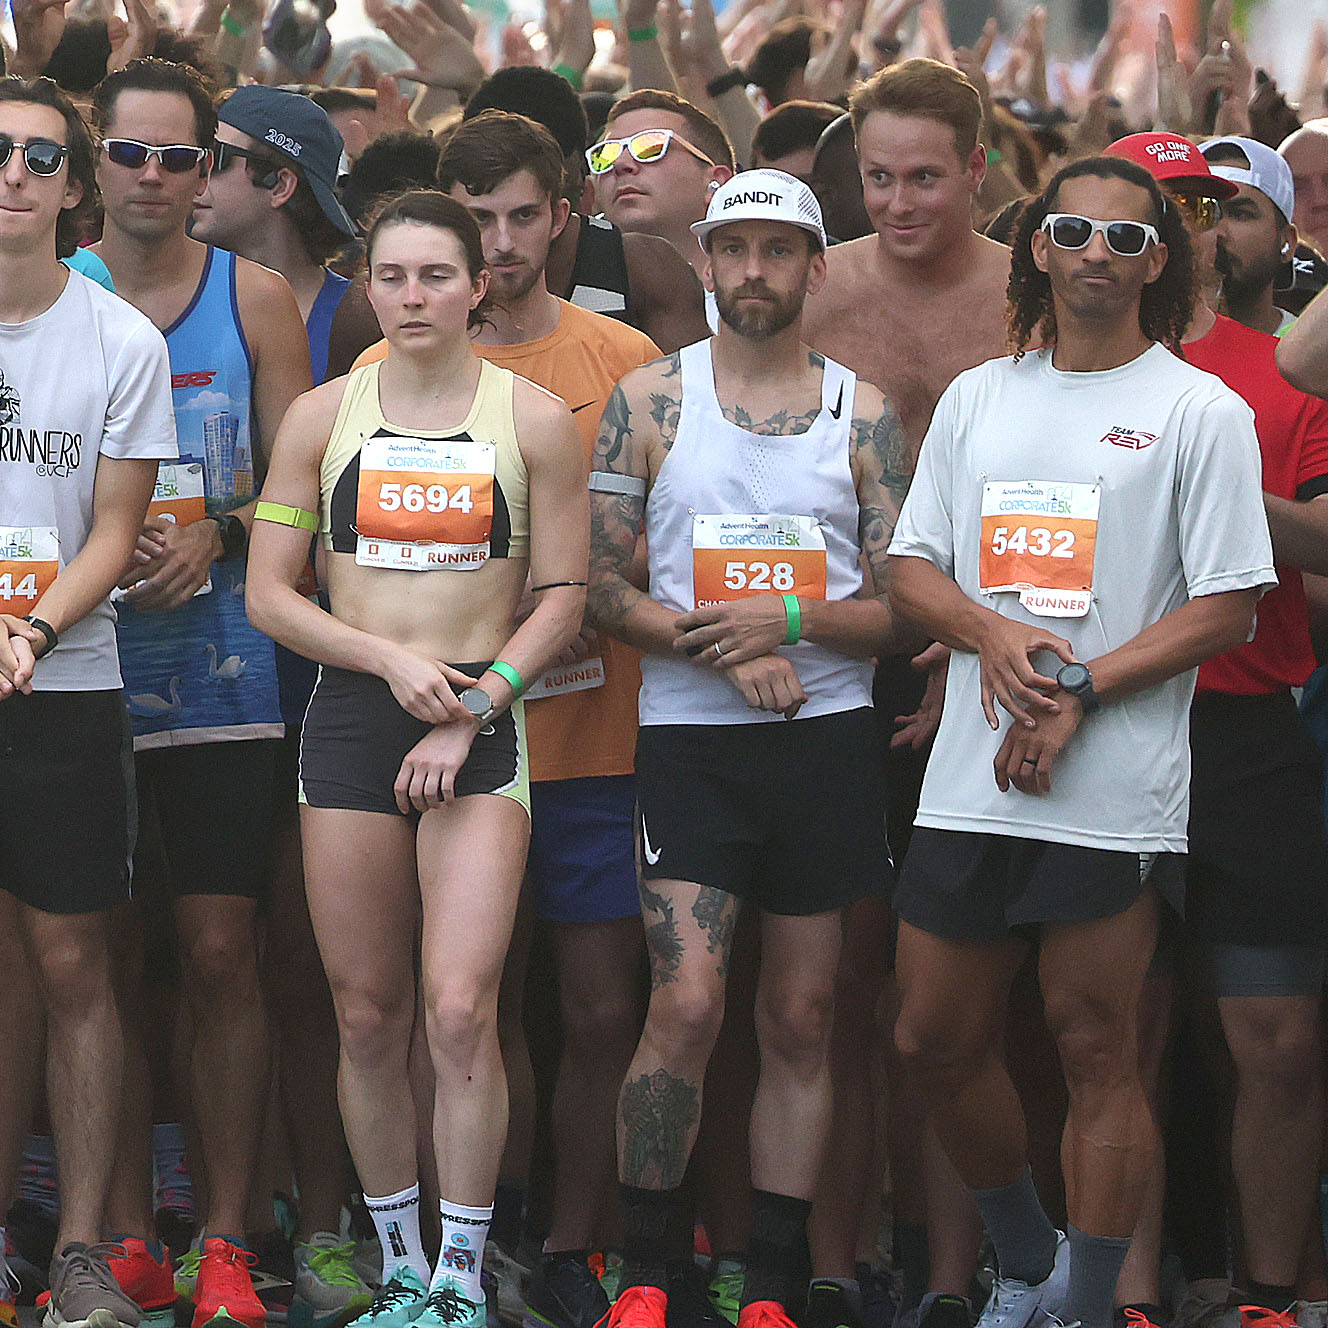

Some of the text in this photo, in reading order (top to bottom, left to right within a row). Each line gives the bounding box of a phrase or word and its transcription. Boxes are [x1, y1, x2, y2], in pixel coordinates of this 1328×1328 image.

[265, 128, 302, 157] 2025
[1145, 141, 1191, 155] GO ONE
[1157, 151, 1190, 163] MORE
[723, 191, 783, 210] BANDIT
[1110, 426, 1135, 436] TEAM
[0, 425, 82, 469] RUNNERS
[386, 456, 452, 470] CORPORATE
[378, 483, 475, 514] 5694
[999, 500, 1057, 513] CORPORATE
[719, 534, 784, 546] CORPORATE
[991, 526, 1075, 559] 5432
[428, 551, 487, 564] RUNNER
[723, 561, 795, 591] 528
[1025, 596, 1086, 610] RUNNER
[545, 667, 601, 689] RUNNER
